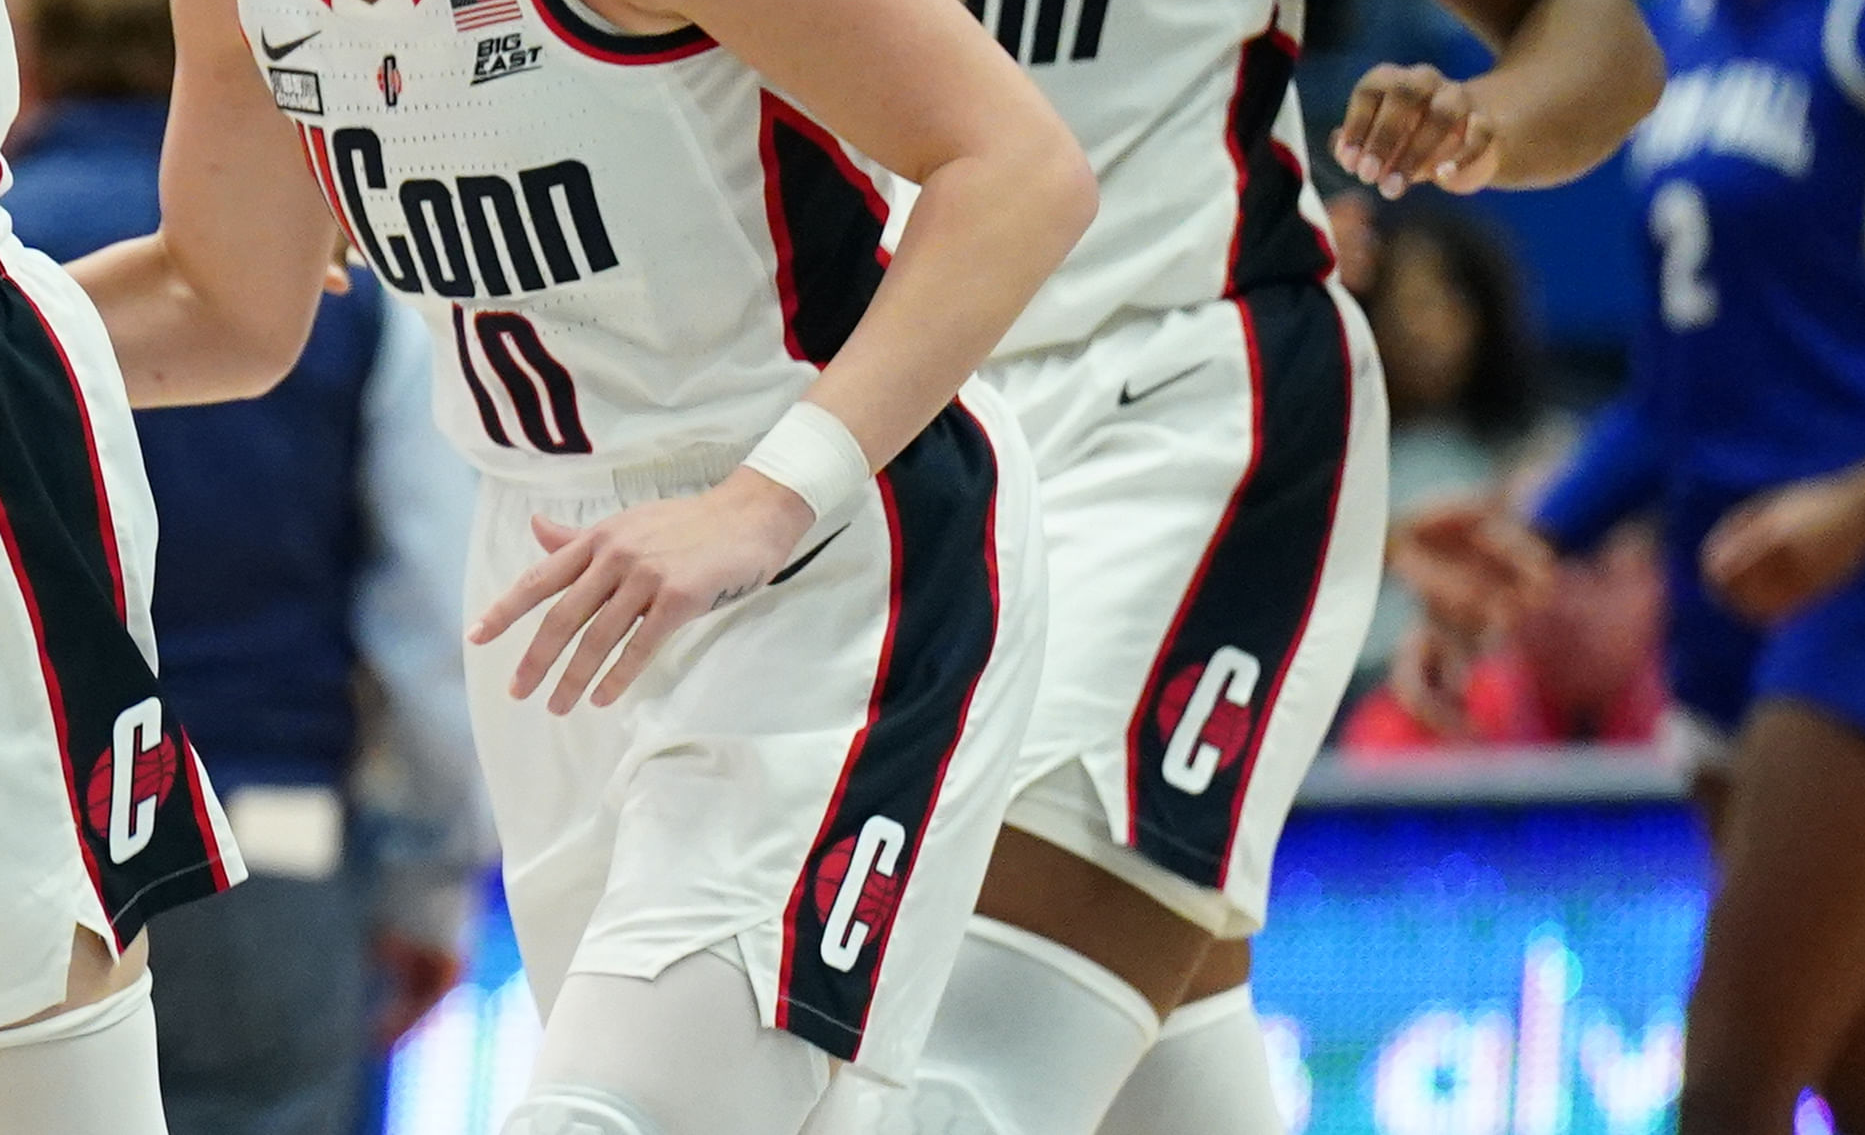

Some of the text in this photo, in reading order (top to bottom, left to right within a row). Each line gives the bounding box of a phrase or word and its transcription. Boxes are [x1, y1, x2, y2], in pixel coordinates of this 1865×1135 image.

[474, 46, 542, 76] EAST
[477, 33, 521, 58] BIG
[451, 301, 592, 454] 10
[109, 696, 162, 864] C
[1162, 645, 1261, 796] C
[820, 815, 906, 973] C
